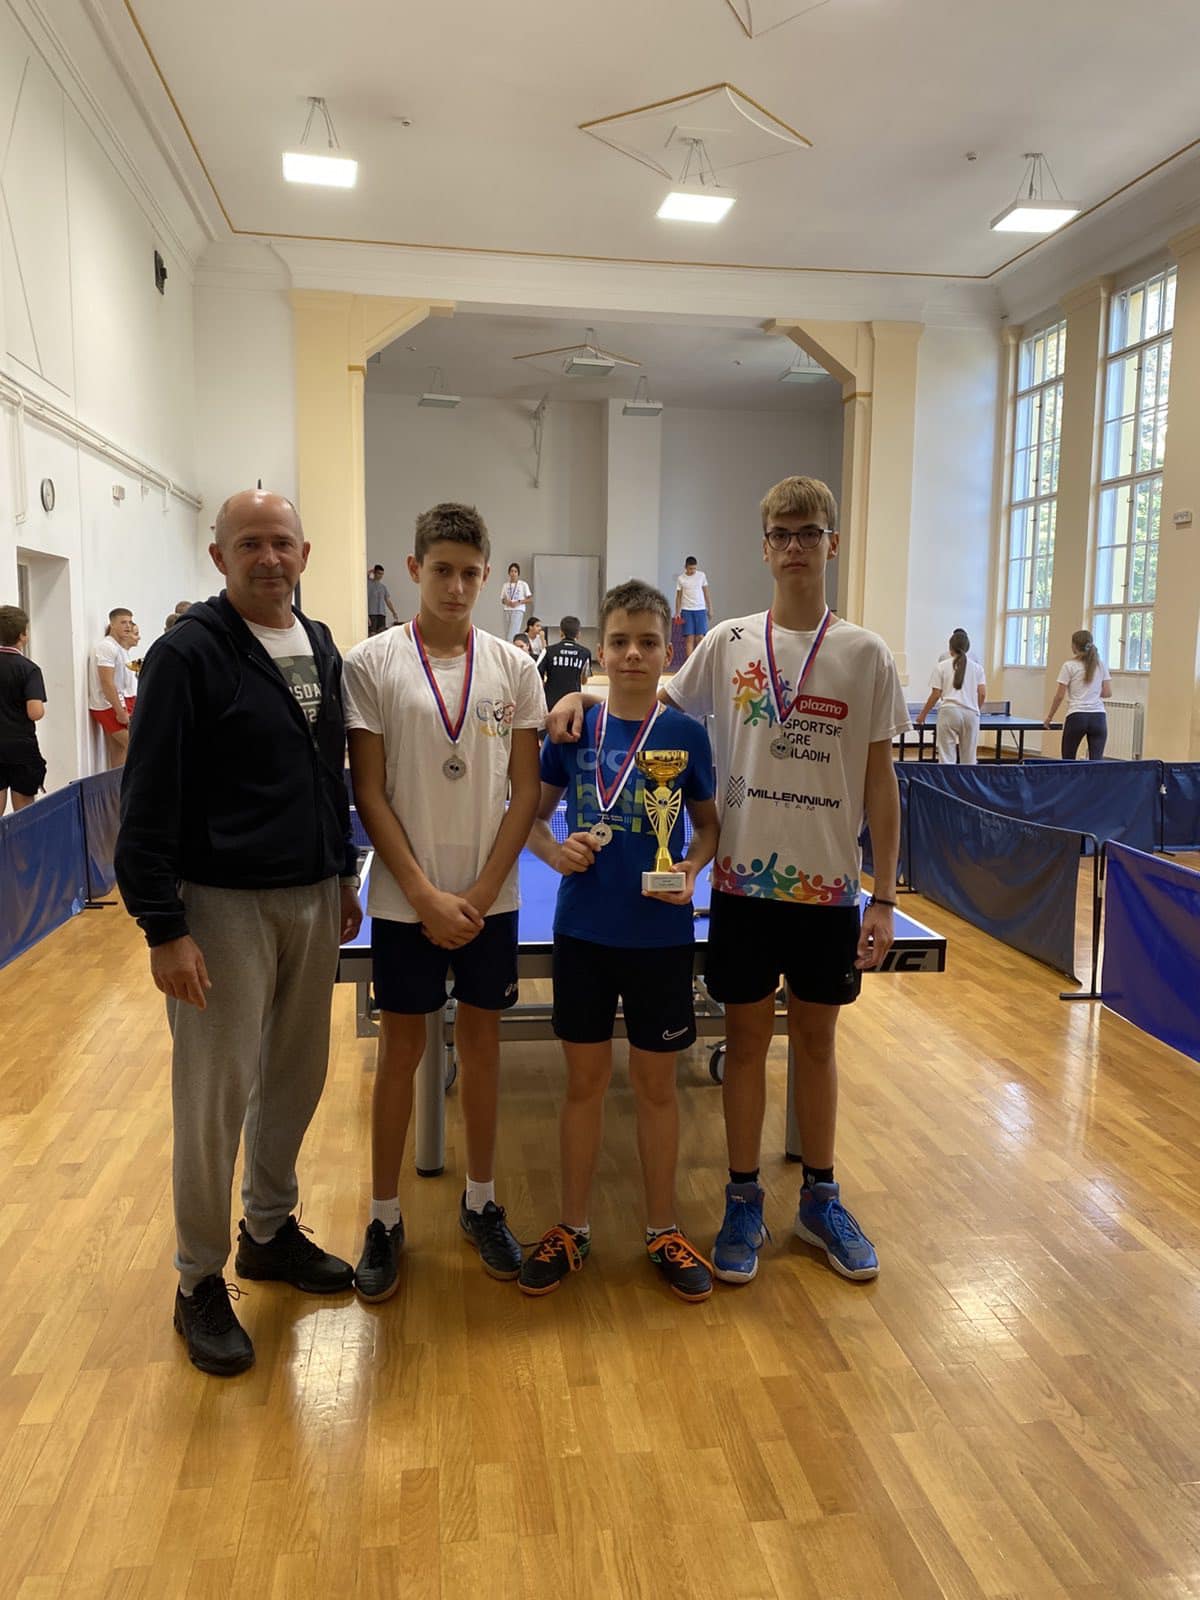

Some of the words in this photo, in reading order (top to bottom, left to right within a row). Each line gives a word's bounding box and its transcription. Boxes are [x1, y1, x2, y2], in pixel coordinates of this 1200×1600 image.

[289, 683, 322, 700] SDA
[799, 698, 843, 715] plazma
[747, 788, 841, 809] MILLENNIUM
